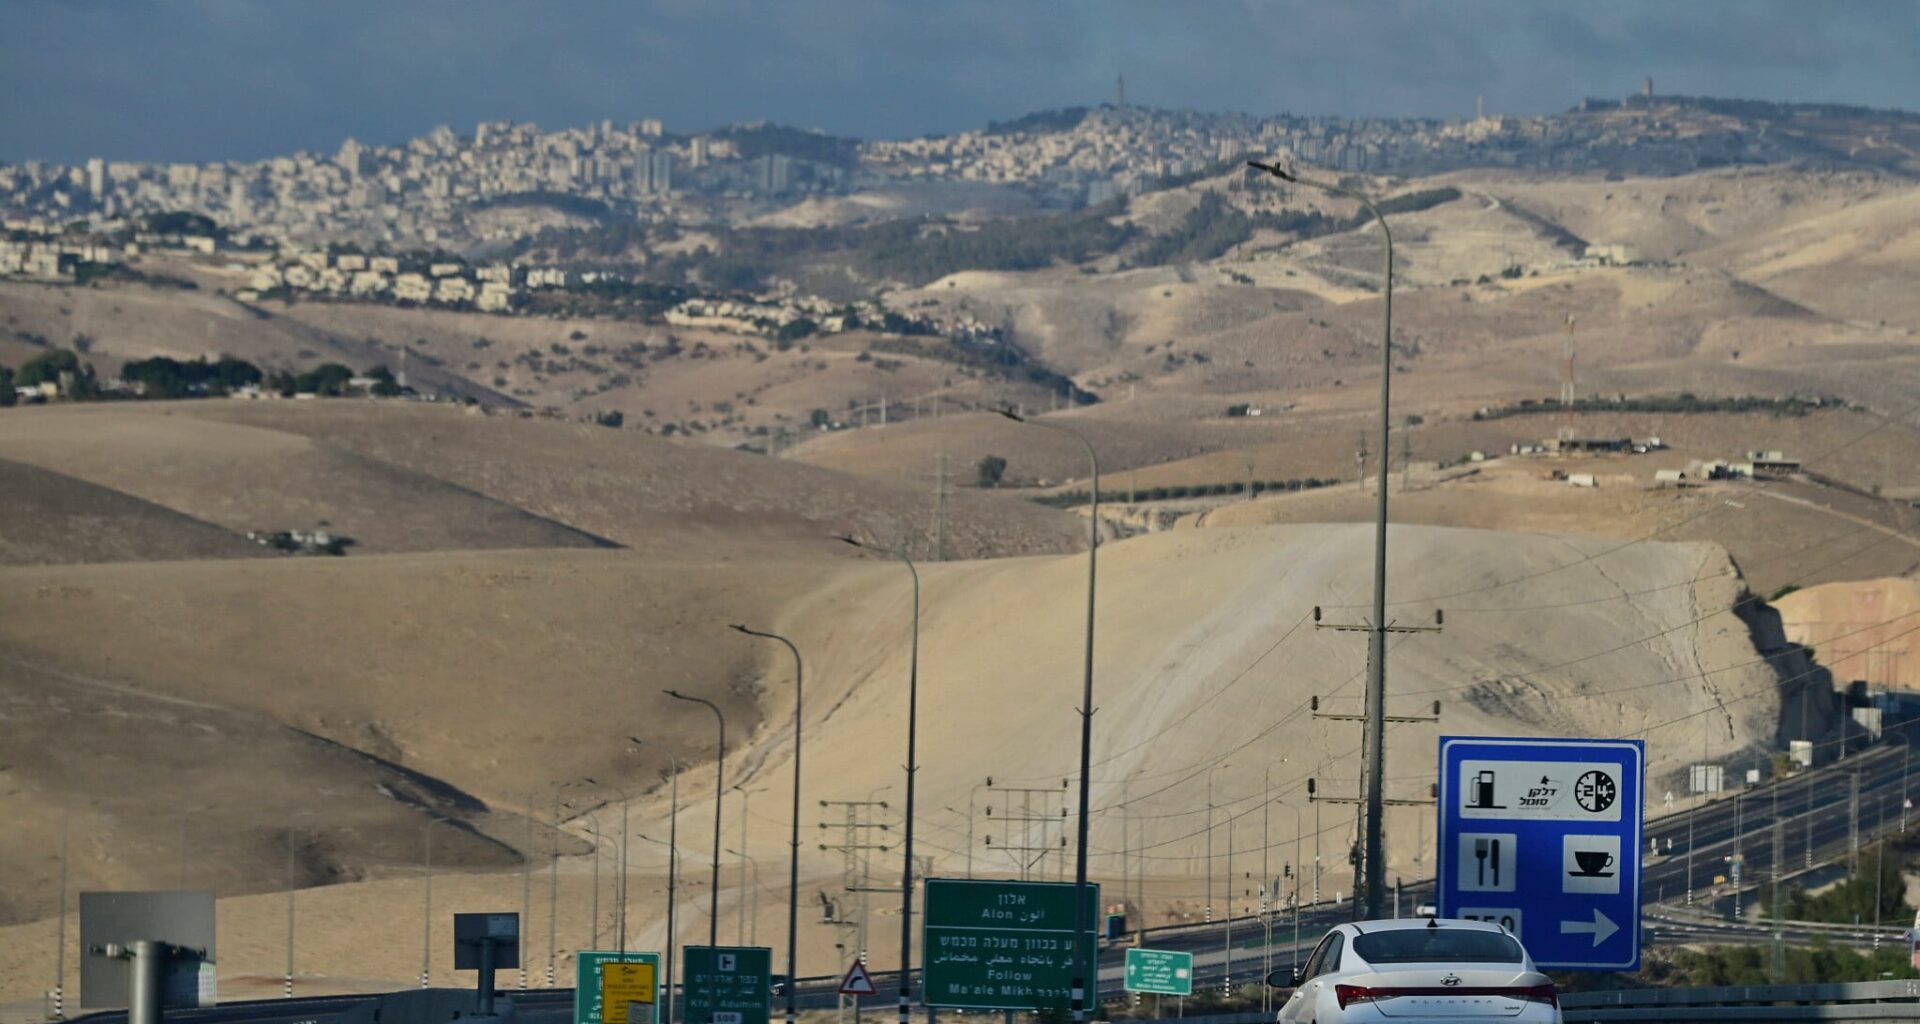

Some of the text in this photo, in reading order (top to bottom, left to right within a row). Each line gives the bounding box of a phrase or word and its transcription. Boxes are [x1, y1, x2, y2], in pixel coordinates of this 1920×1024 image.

[1528, 787, 1557, 798] דלקן
[1583, 785, 1609, 798] 24
[998, 893, 1026, 905] אלון
[982, 908, 1013, 919] Alon
[987, 969, 1032, 980] Follow
[948, 984, 994, 995] Ma'ale
